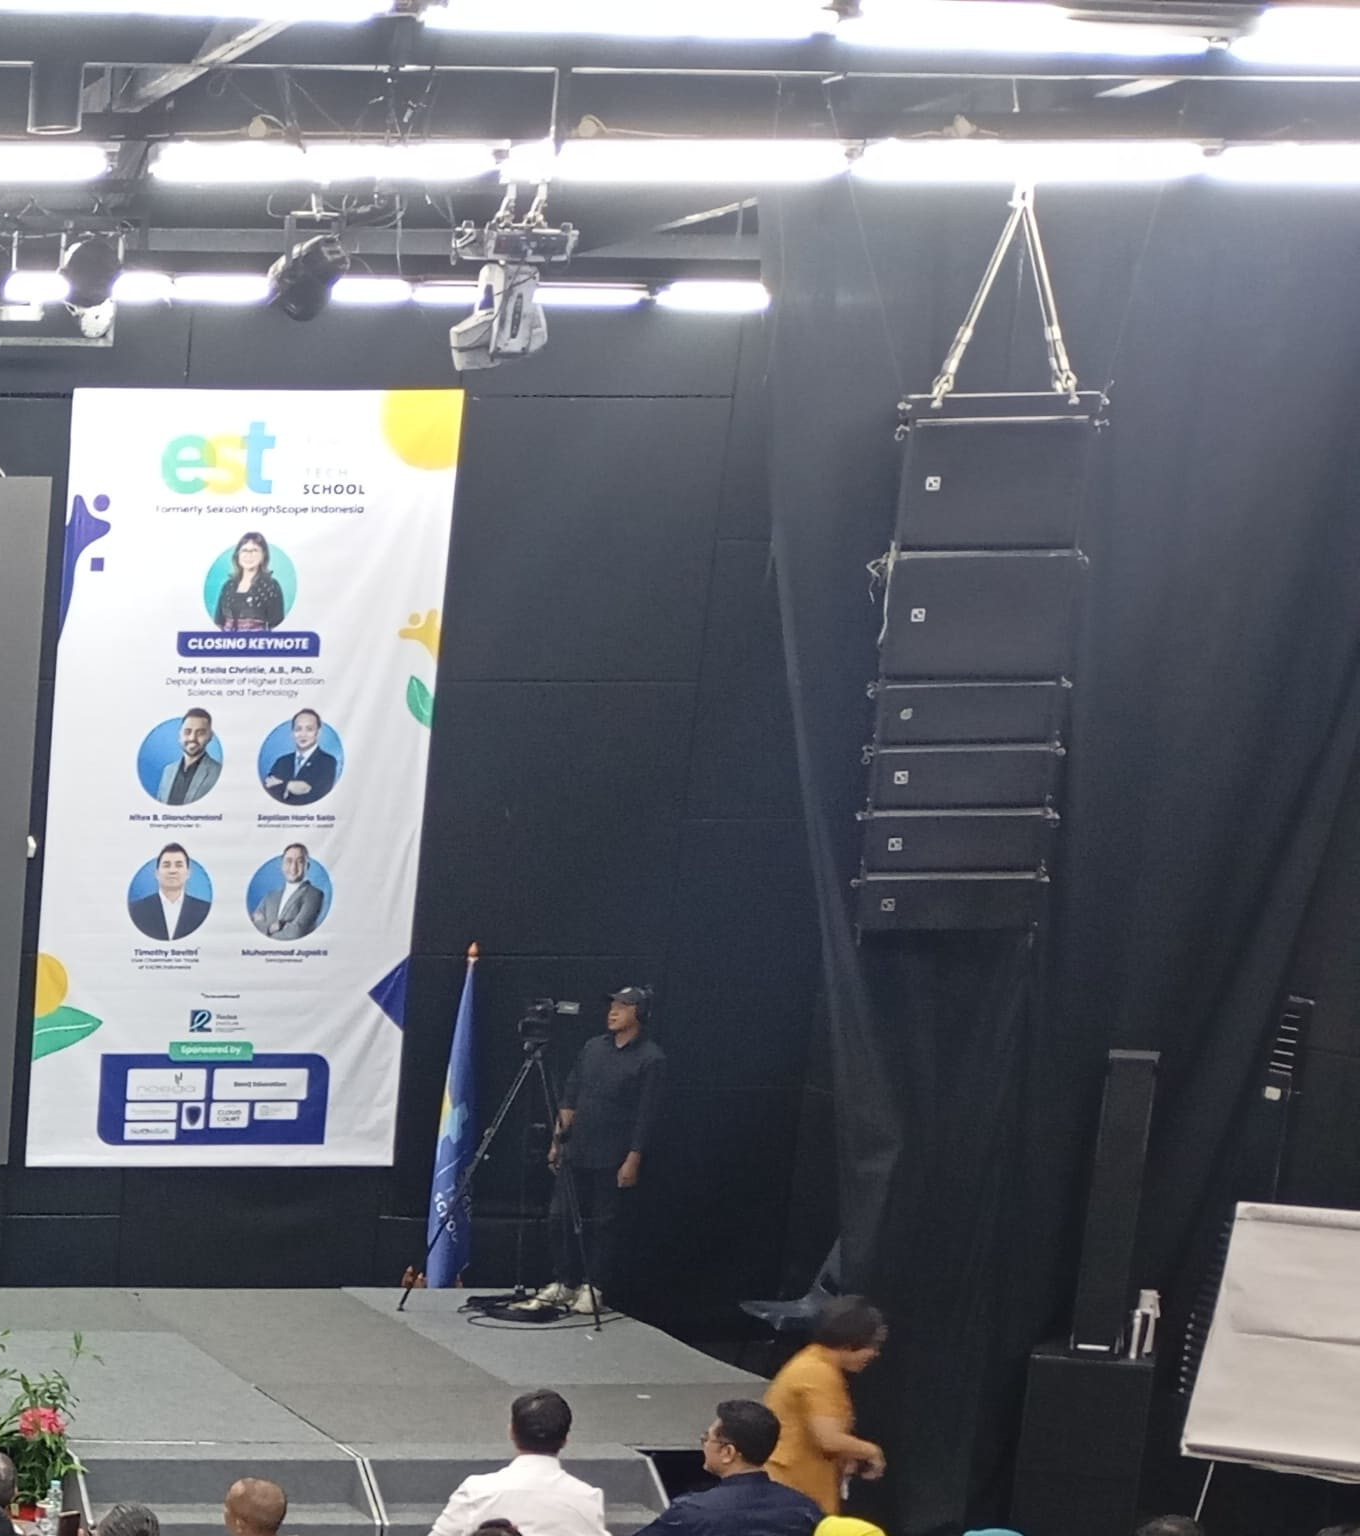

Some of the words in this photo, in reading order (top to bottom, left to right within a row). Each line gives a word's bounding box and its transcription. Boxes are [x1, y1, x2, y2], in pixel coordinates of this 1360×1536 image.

[161, 420, 276, 495] est
[303, 483, 365, 495] SCHOOL
[251, 505, 308, 515] HighScope
[311, 504, 365, 513] Indonesia
[187, 637, 246, 650] CLOSING
[248, 637, 310, 650] KEYNOTE
[178, 666, 198, 674] Prof.
[201, 666, 227, 674] Stella
[165, 677, 197, 687] Deputy
[200, 677, 234, 685] Minister
[237, 677, 246, 685] of
[247, 677, 277, 687] Higher
[279, 677, 325, 685] Education
[226, 688, 245, 697] and
[247, 688, 299, 699] Technology
[180, 1045, 228, 1055] Sponsored
[228, 1045, 242, 1055] by
